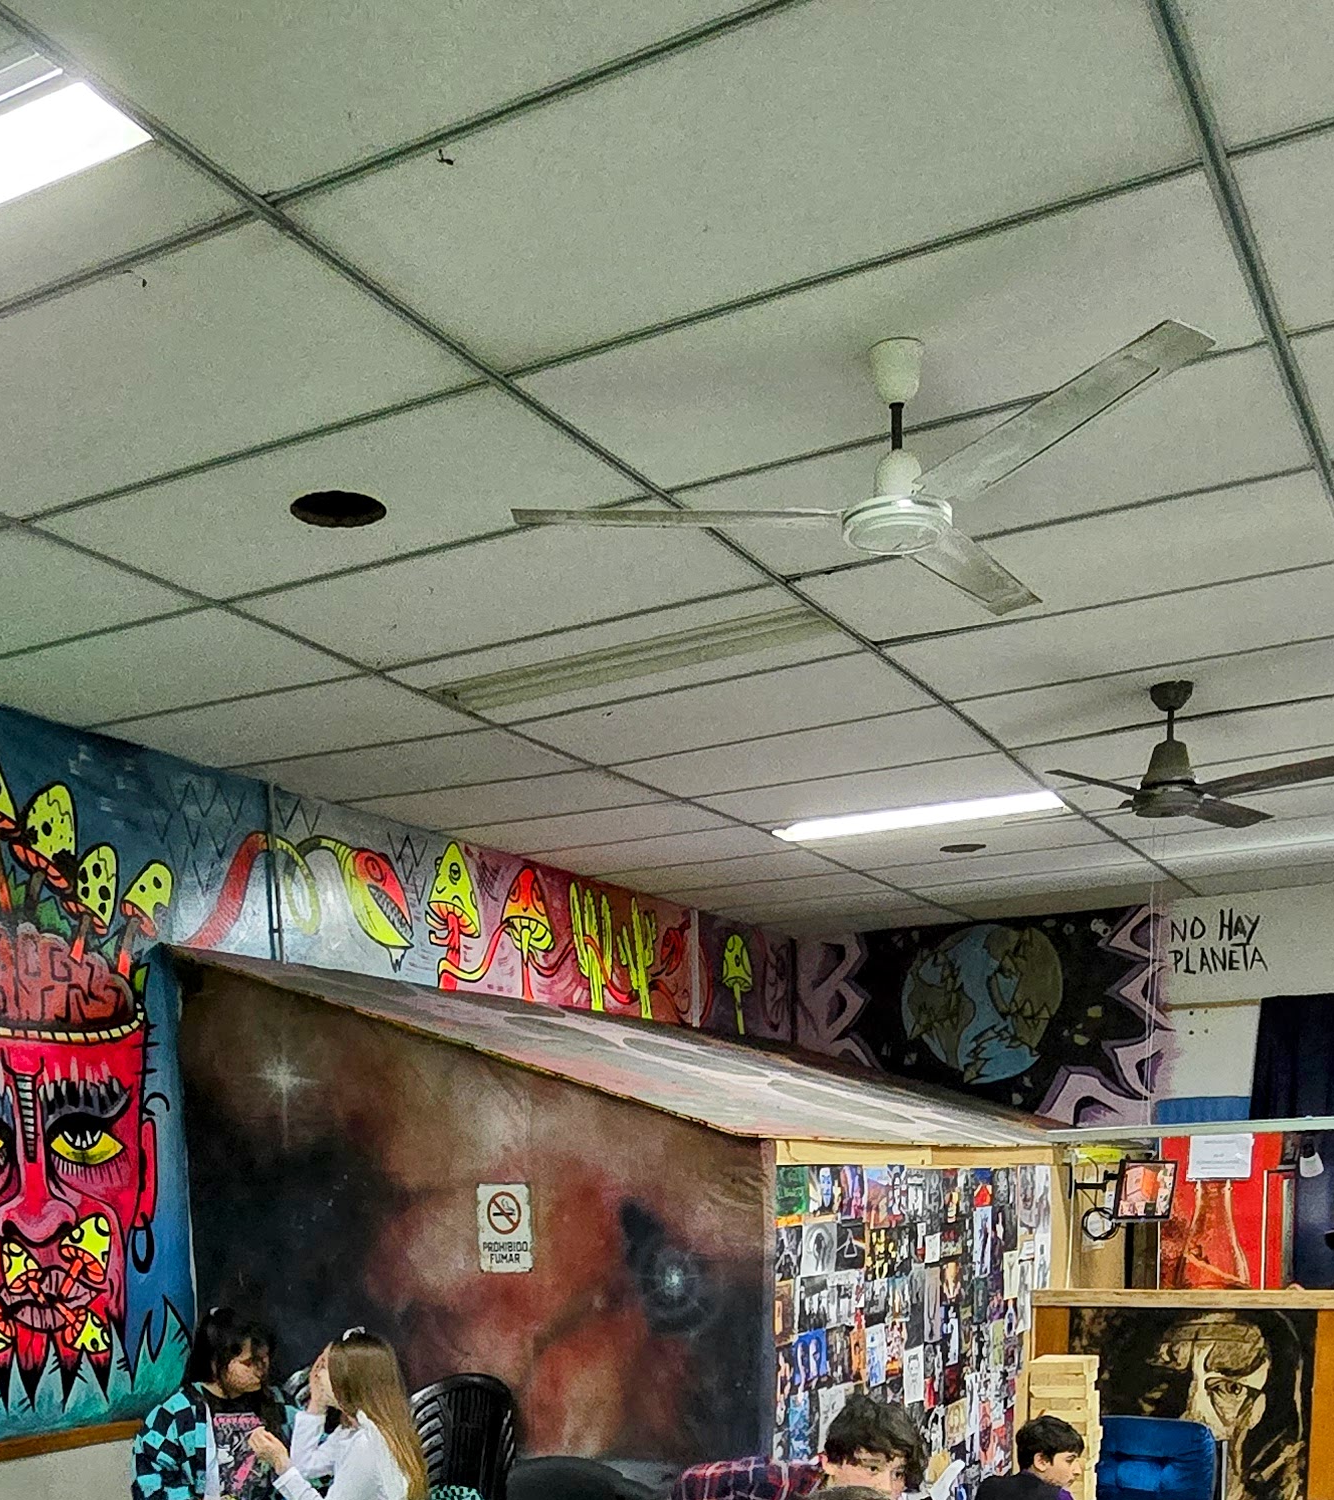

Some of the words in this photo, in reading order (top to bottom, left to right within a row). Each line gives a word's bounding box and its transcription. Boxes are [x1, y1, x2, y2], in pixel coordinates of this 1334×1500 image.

[1169, 915, 1206, 943] NO
[1218, 906, 1261, 945] HAY
[1168, 941, 1269, 975] PLANETA
[482, 1241, 528, 1253] PROHIBIDO
[489, 1253, 521, 1265] FUMAR
